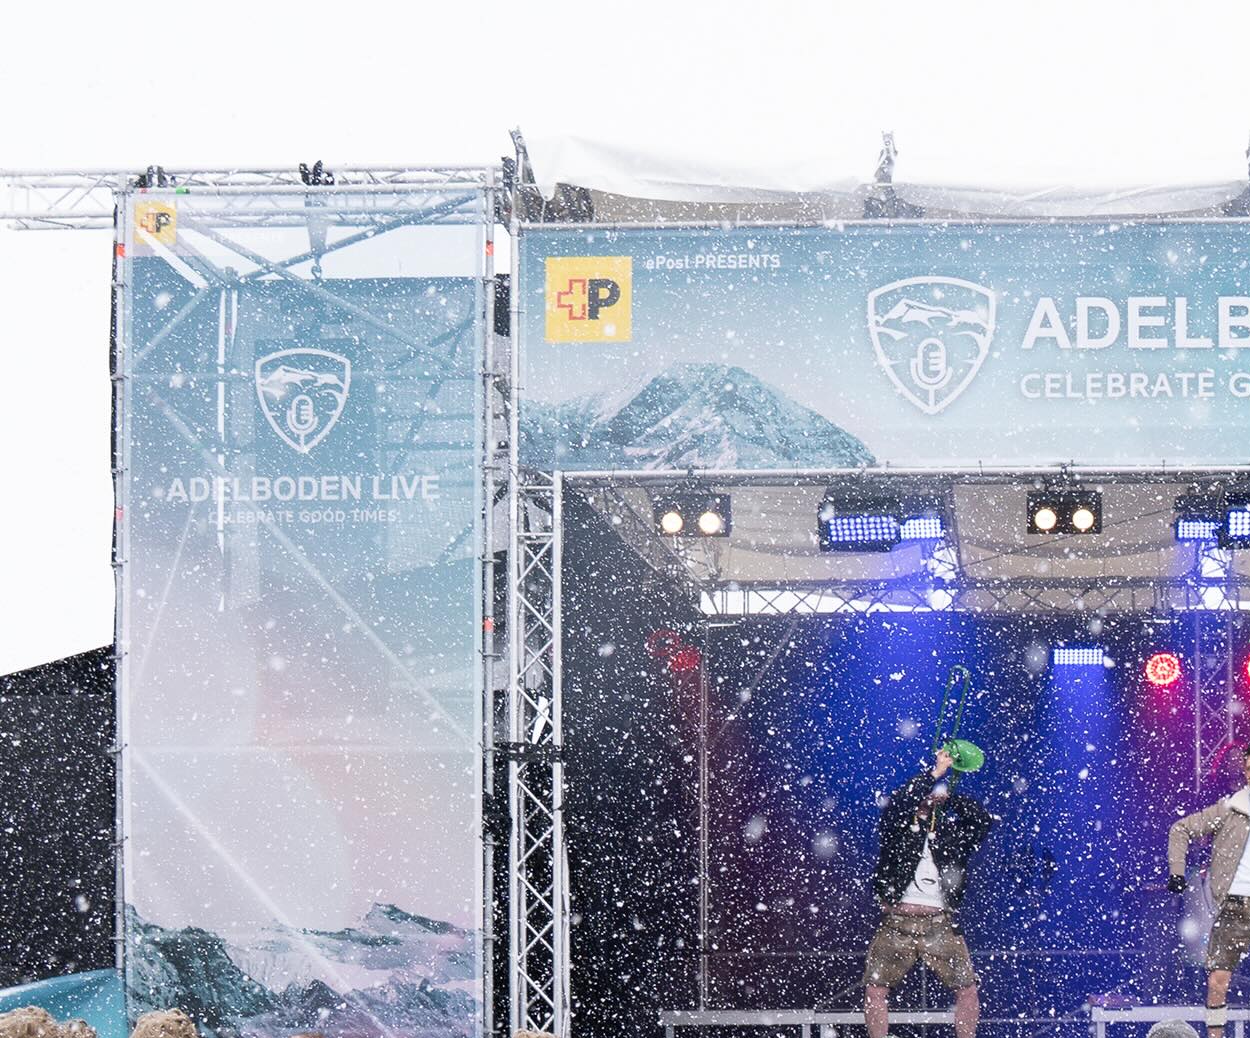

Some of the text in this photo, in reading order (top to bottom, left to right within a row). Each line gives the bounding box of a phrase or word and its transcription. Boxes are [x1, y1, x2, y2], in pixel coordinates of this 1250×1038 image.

[644, 254, 781, 270] ePost PRESENTS
[1020, 372, 1215, 399] CELEBRATE
[167, 475, 440, 501] ADELBODEN LIVE
[208, 508, 397, 524] CELEBRATE GOOD TIMES
